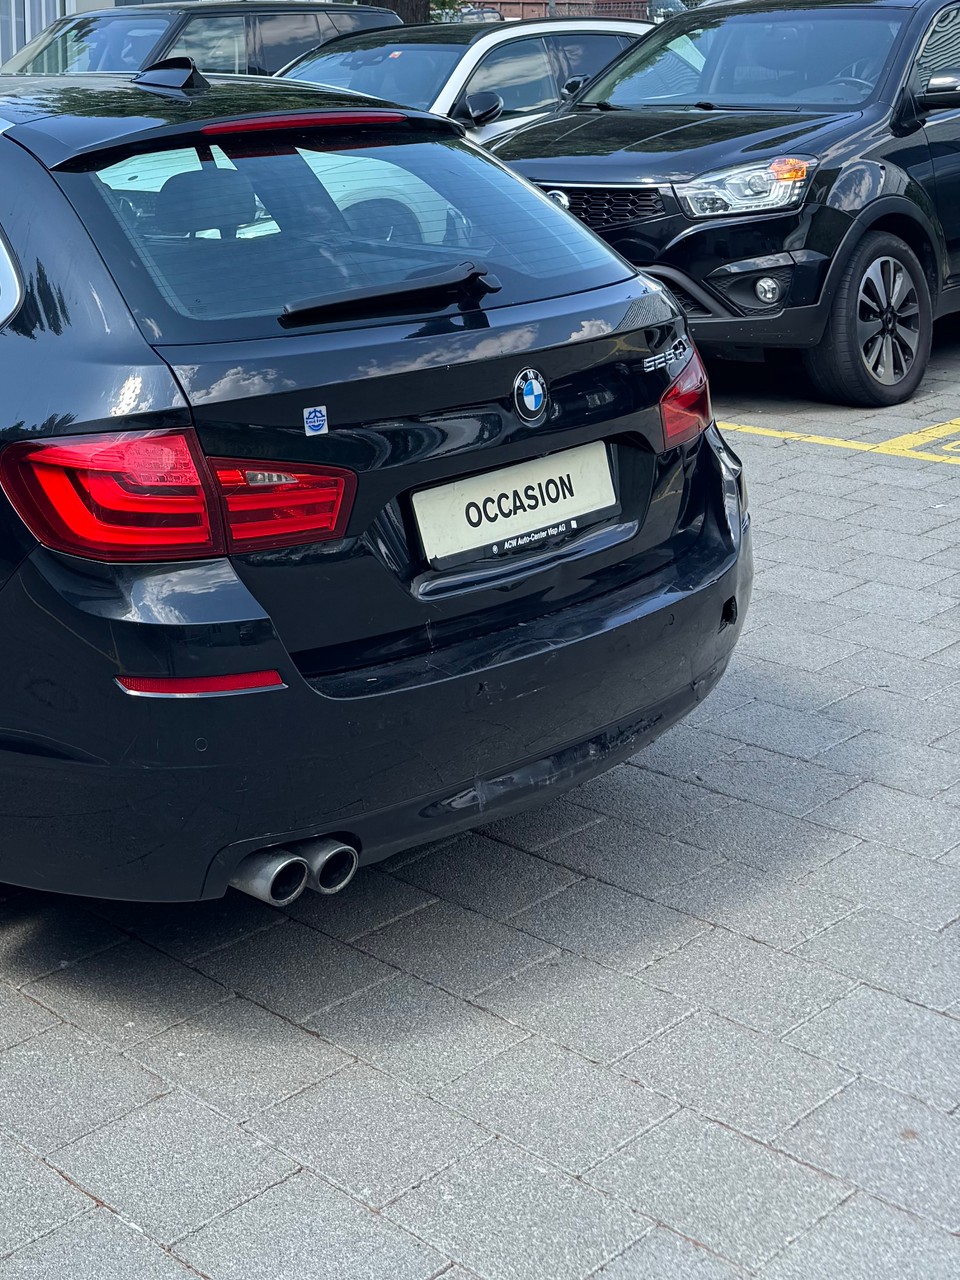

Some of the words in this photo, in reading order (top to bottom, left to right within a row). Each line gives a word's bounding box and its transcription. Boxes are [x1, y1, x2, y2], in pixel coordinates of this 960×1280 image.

[465, 473, 575, 528] OCCASION
[504, 539, 517, 550] ACW
[517, 530, 547, 546] Auto-Center
[558, 523, 566, 533] AG
